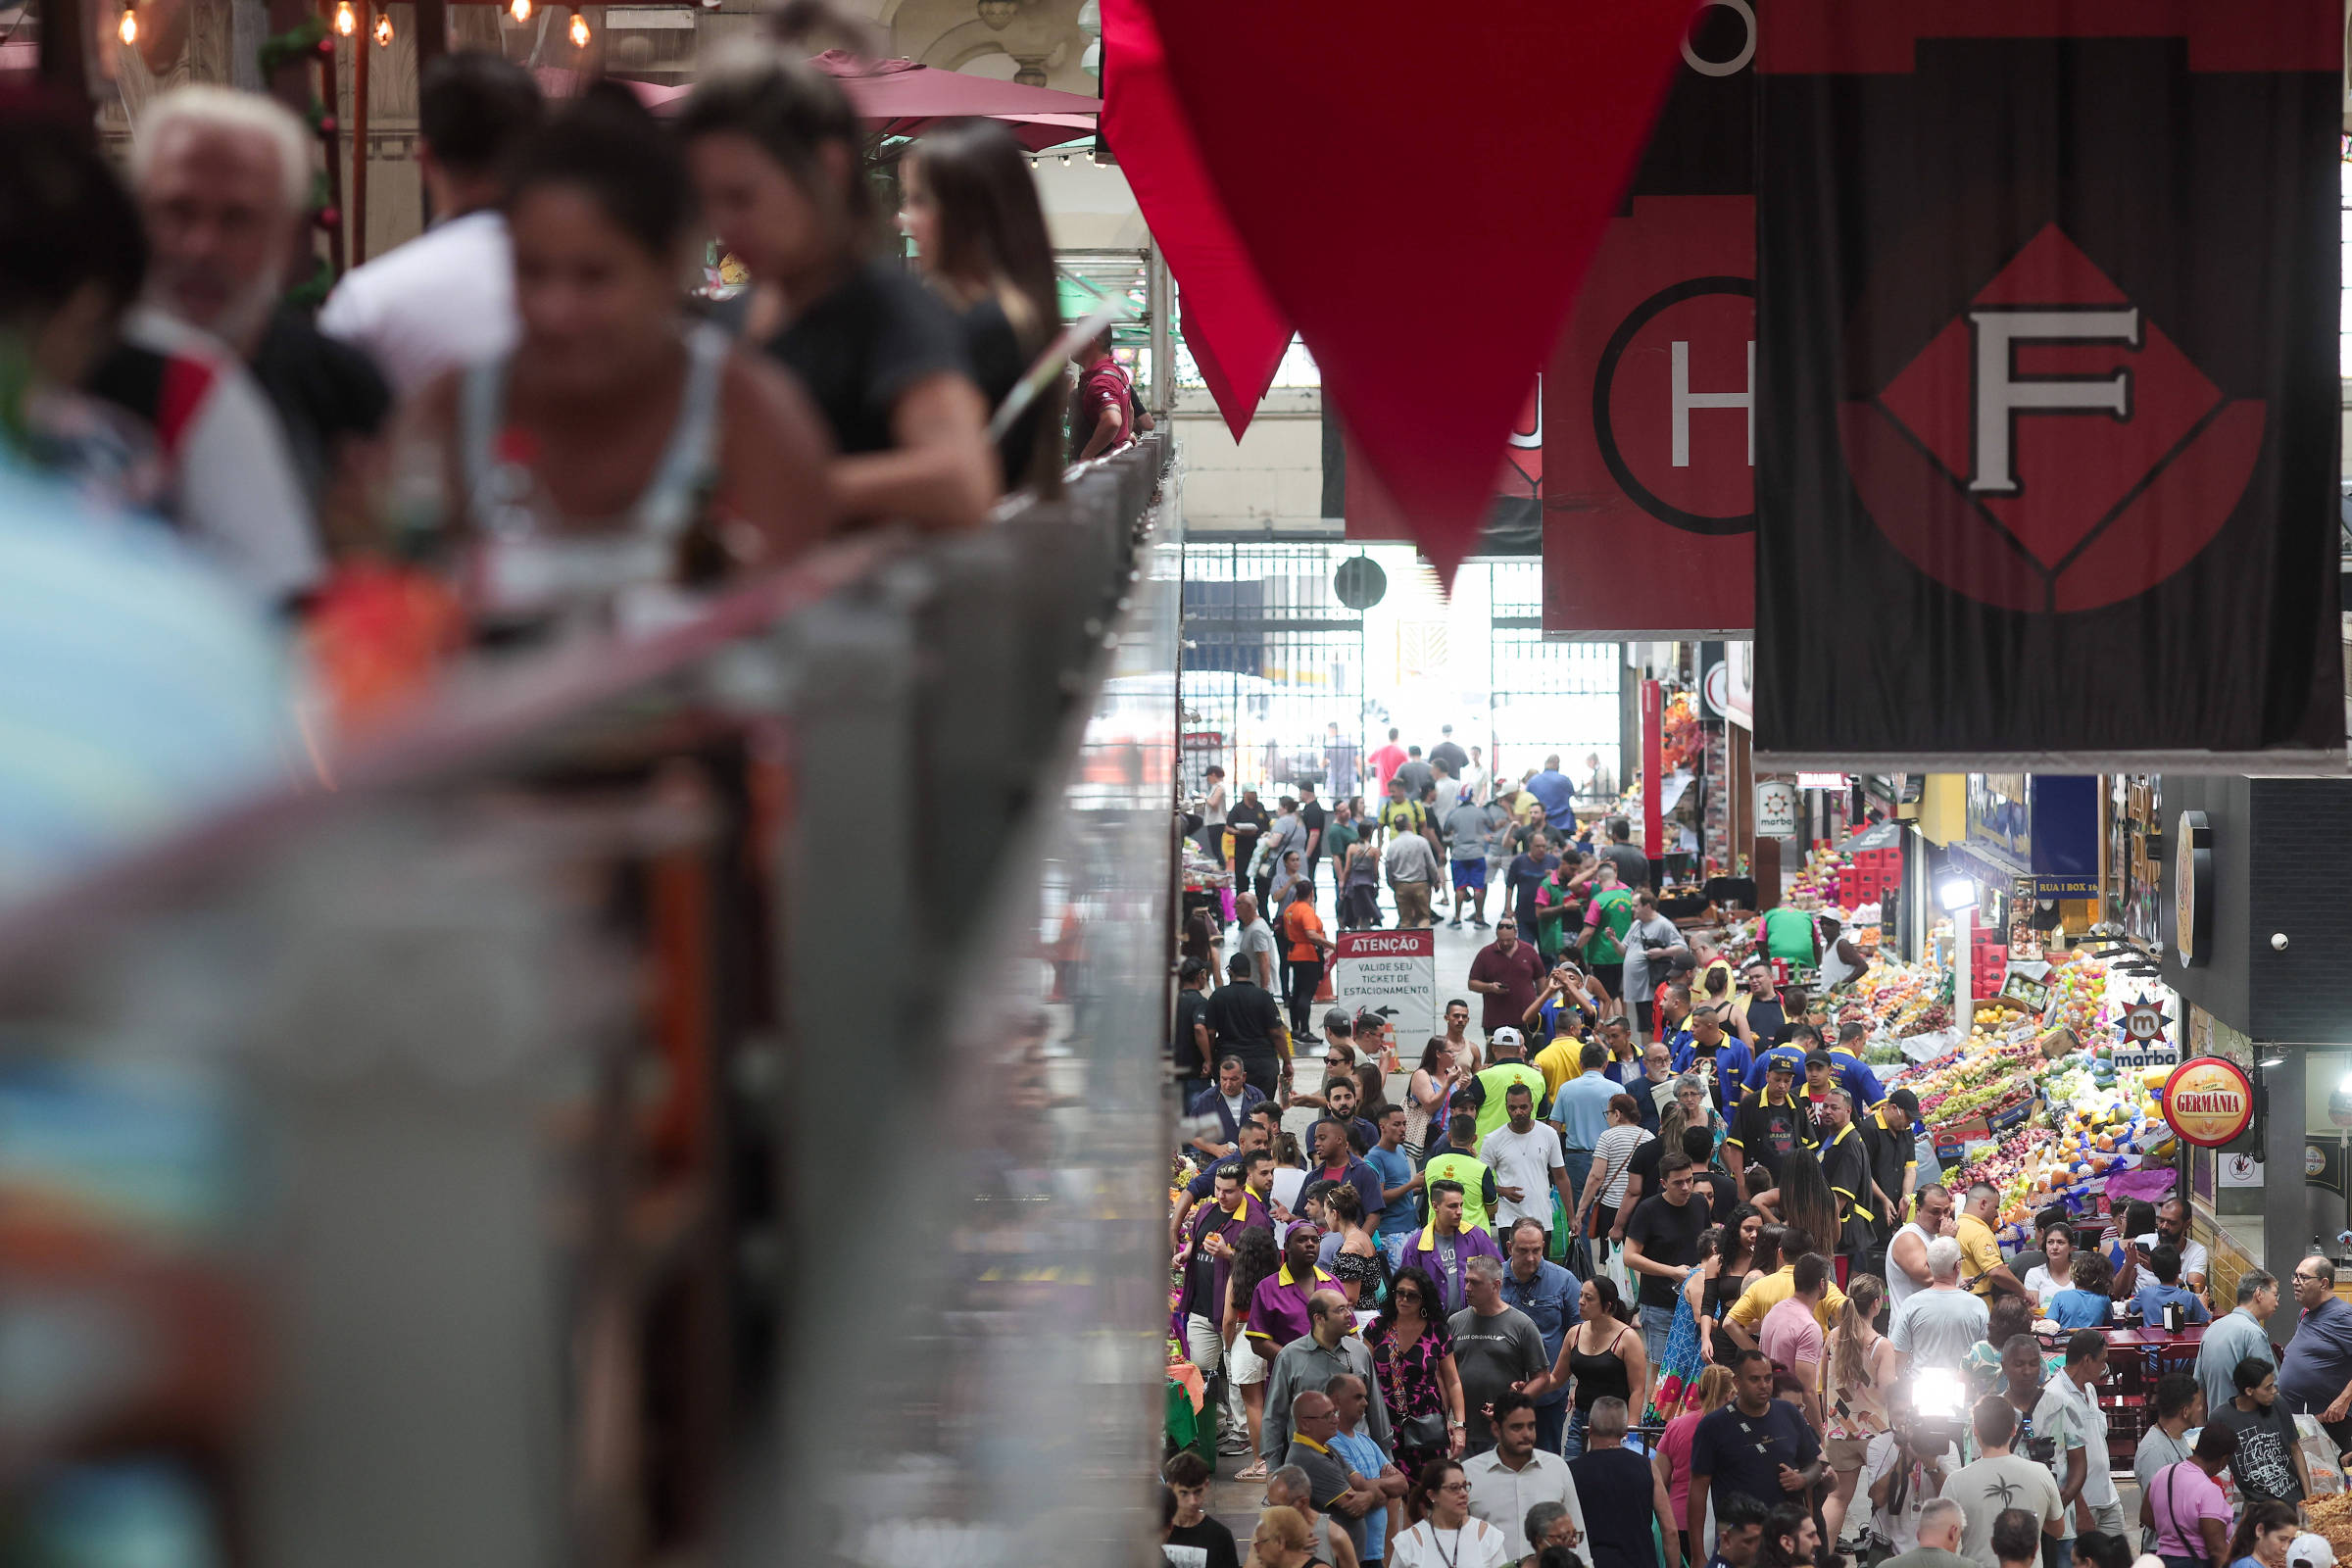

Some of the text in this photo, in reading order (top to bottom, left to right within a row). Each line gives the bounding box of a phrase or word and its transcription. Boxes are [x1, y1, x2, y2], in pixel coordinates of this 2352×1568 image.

[1671, 340, 1756, 467] H
[1969, 307, 2138, 491] F
[1761, 817, 1792, 826] marba
[2039, 883, 2059, 892] RUA
[2067, 883, 2085, 892] BOX
[1351, 936, 1419, 954] ATENÇÃO
[1358, 963, 1413, 972] VALIDE SEU
[1361, 974, 1410, 983] TICKET DE
[1344, 986, 1429, 997] ESTACIONAMENTO
[2132, 1014, 2156, 1031] m
[2114, 1050, 2177, 1067] marba
[2177, 1092, 2239, 1113] GERMÂNIA
